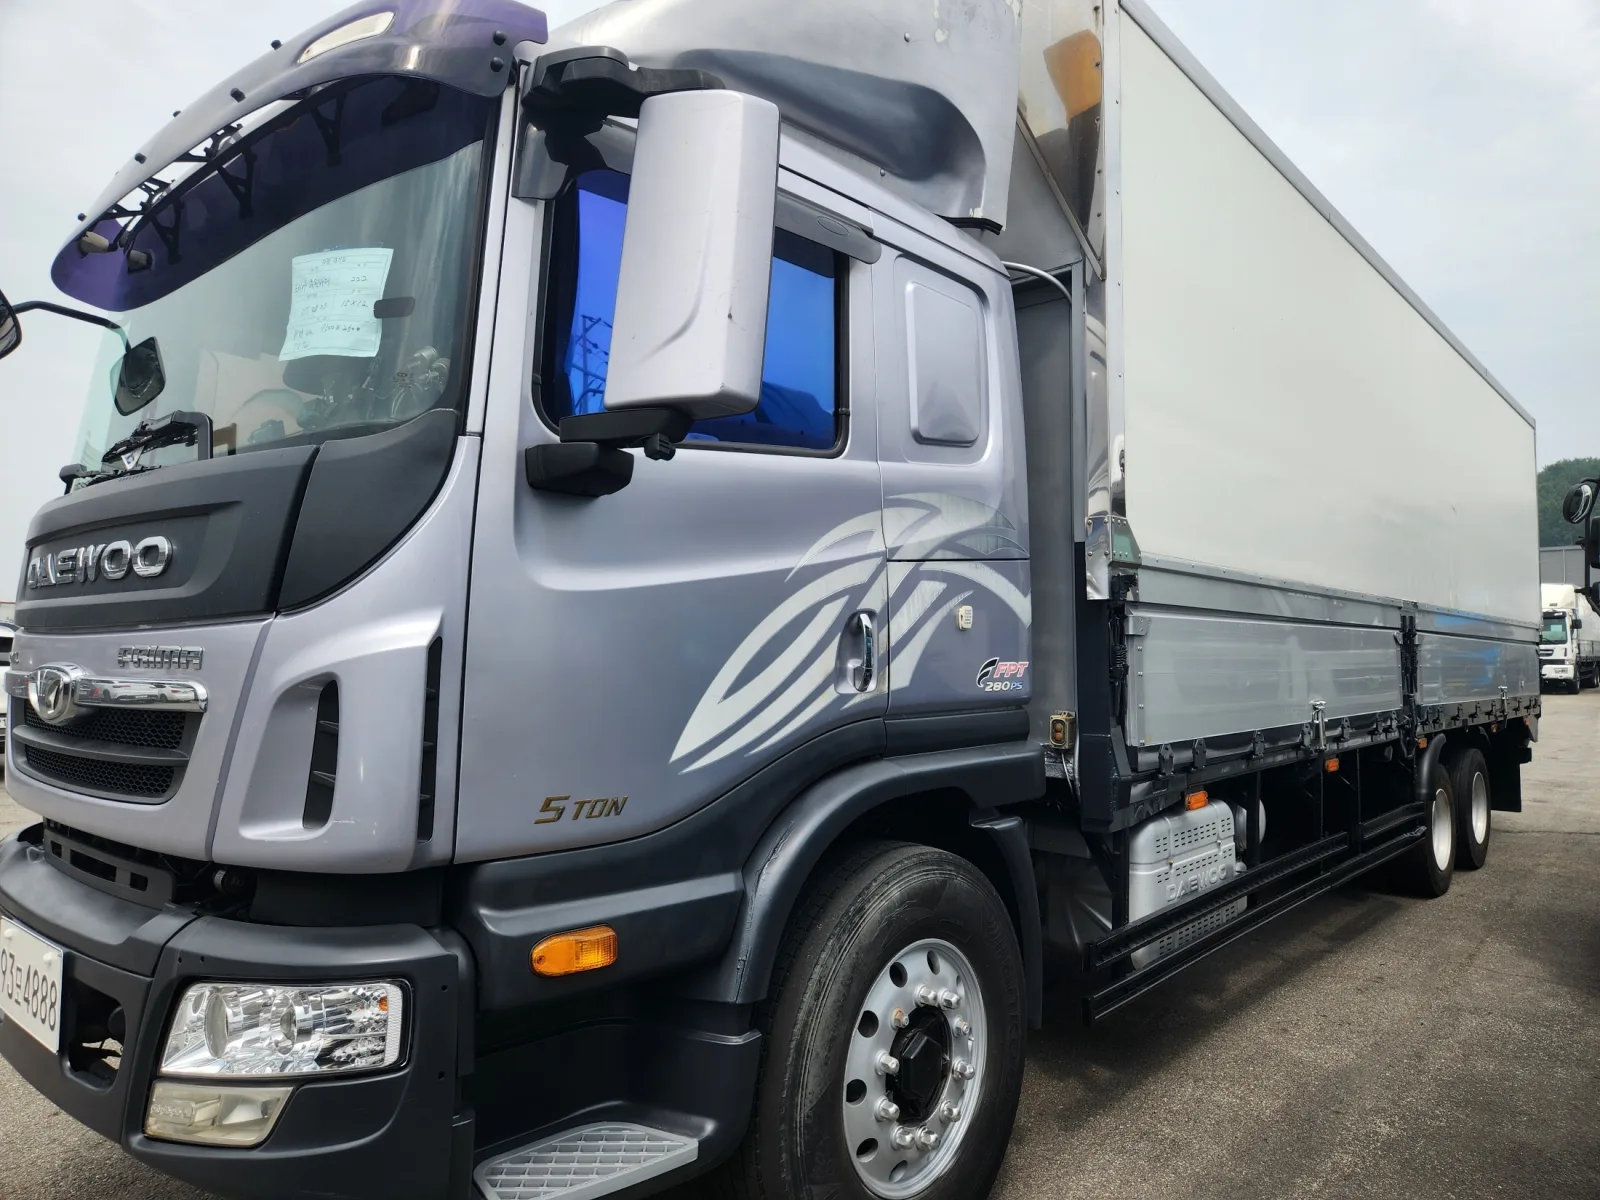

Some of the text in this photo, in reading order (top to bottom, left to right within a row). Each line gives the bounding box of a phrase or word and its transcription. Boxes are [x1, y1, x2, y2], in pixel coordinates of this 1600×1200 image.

[993, 661, 1029, 678] FPT
[533, 795, 628, 825] 5 TON
[1166, 863, 1228, 902] DAEWOO
